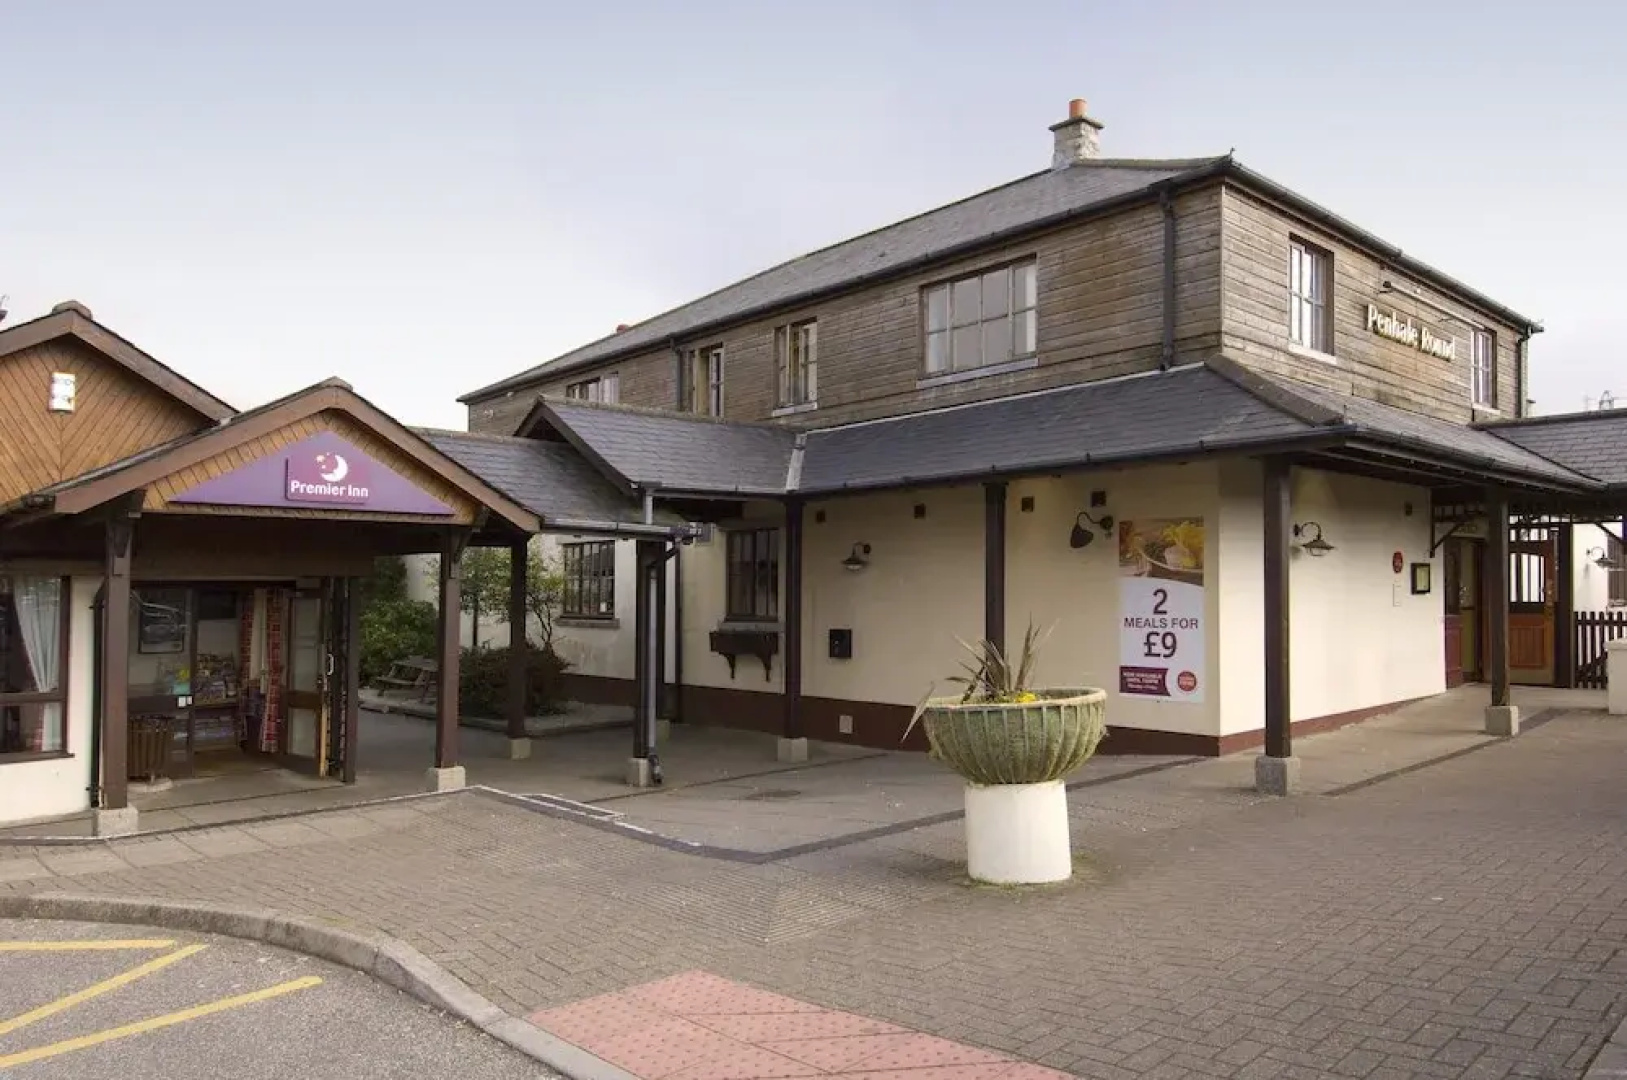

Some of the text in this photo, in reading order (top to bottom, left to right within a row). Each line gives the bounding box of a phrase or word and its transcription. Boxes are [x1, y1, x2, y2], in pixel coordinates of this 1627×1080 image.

[290, 480, 369, 497] Premier Inn
[1152, 588, 1168, 615] 2
[1124, 617, 1199, 630] MEALS FOR
[1143, 631, 1177, 658] £9
